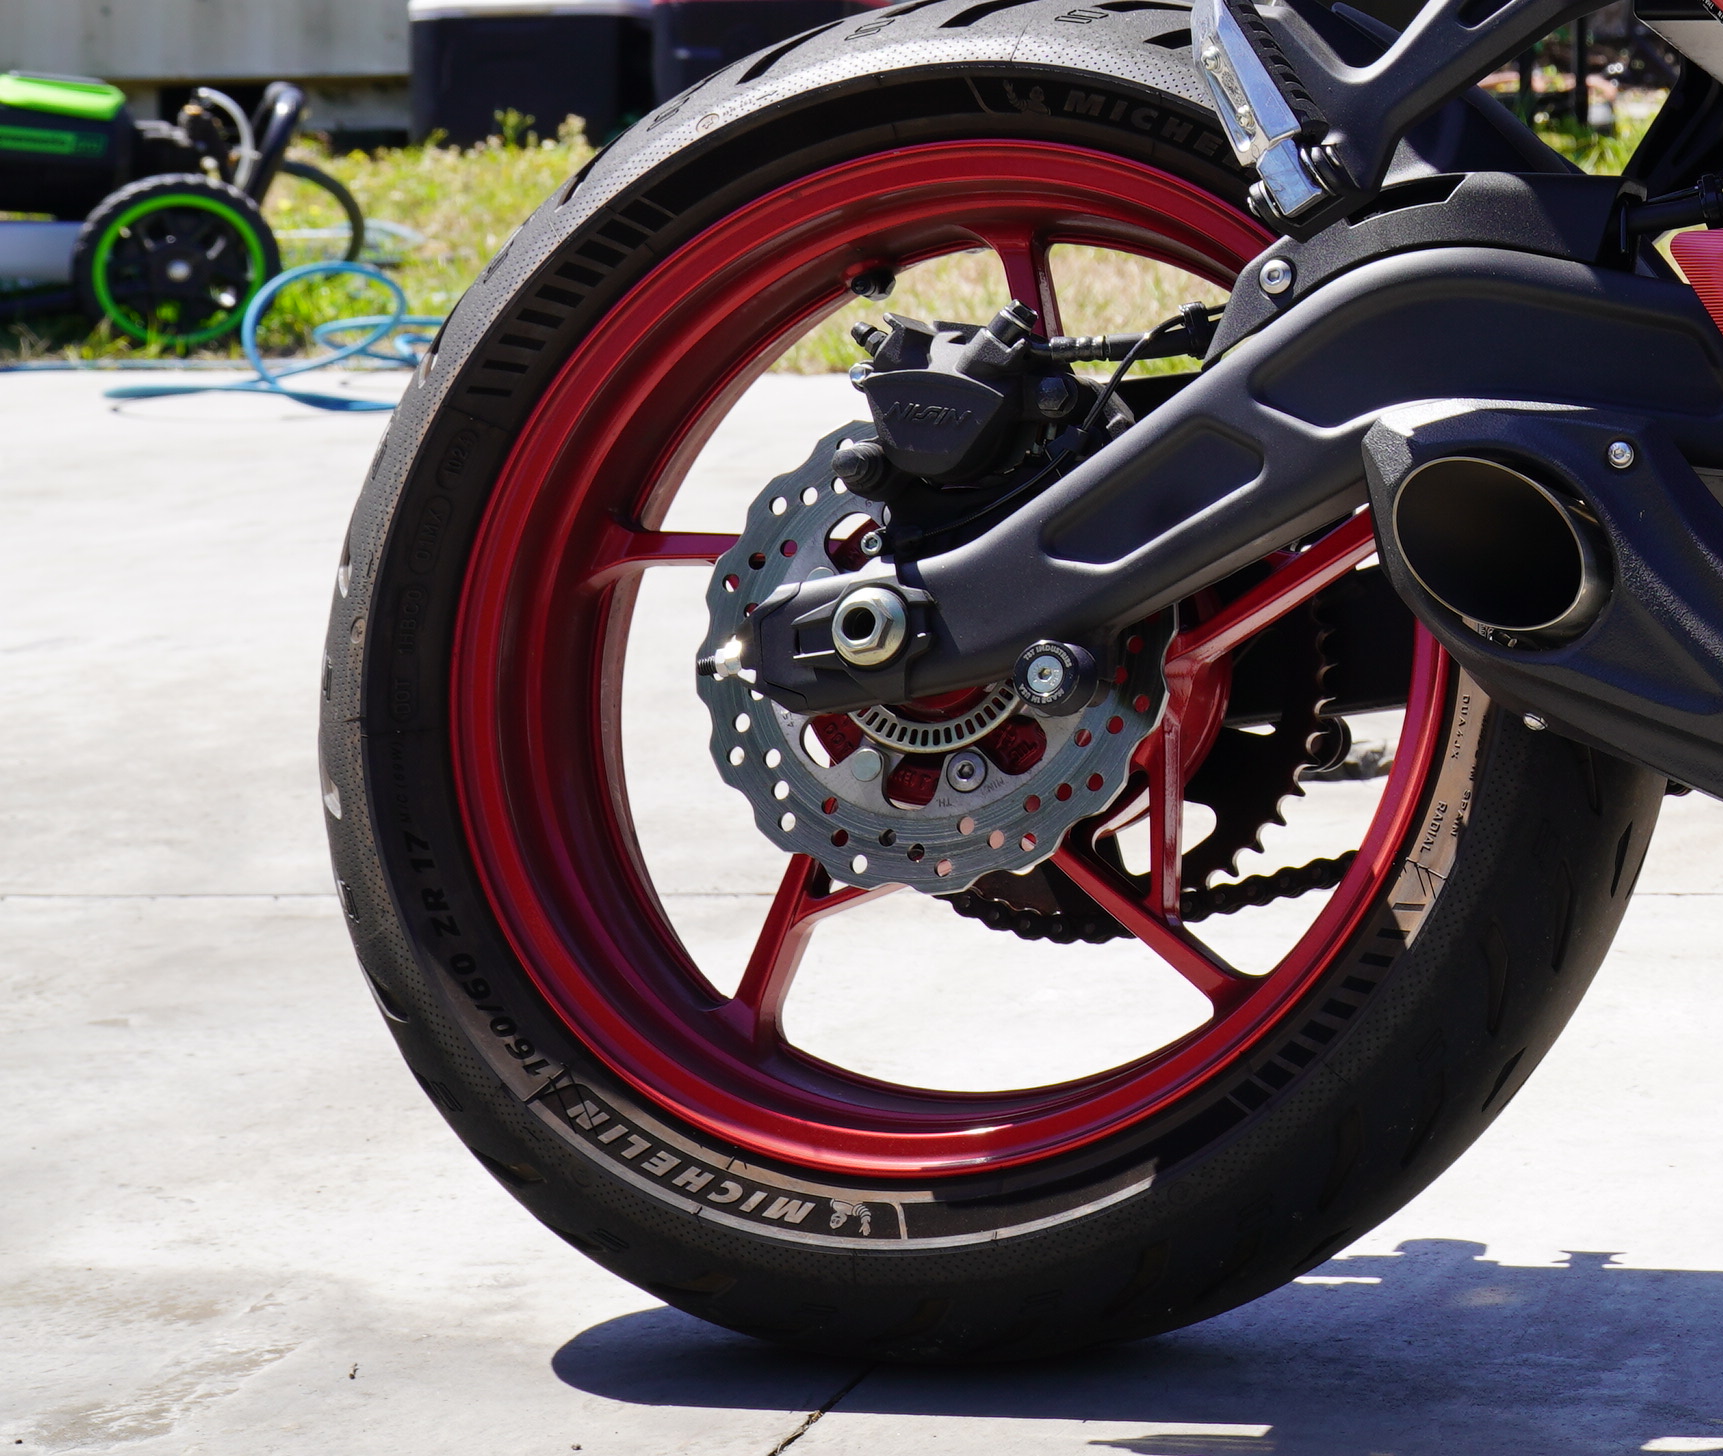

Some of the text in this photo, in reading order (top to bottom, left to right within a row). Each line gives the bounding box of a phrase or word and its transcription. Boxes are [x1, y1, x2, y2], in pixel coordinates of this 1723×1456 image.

[1063, 89, 1260, 183] MICHE
[402, 830, 436, 874] 17
[1420, 800, 1448, 854] RADIAL
[420, 887, 462, 938] ZR
[449, 952, 551, 1077] 160/60
[566, 1100, 817, 1224] MICHELIN
